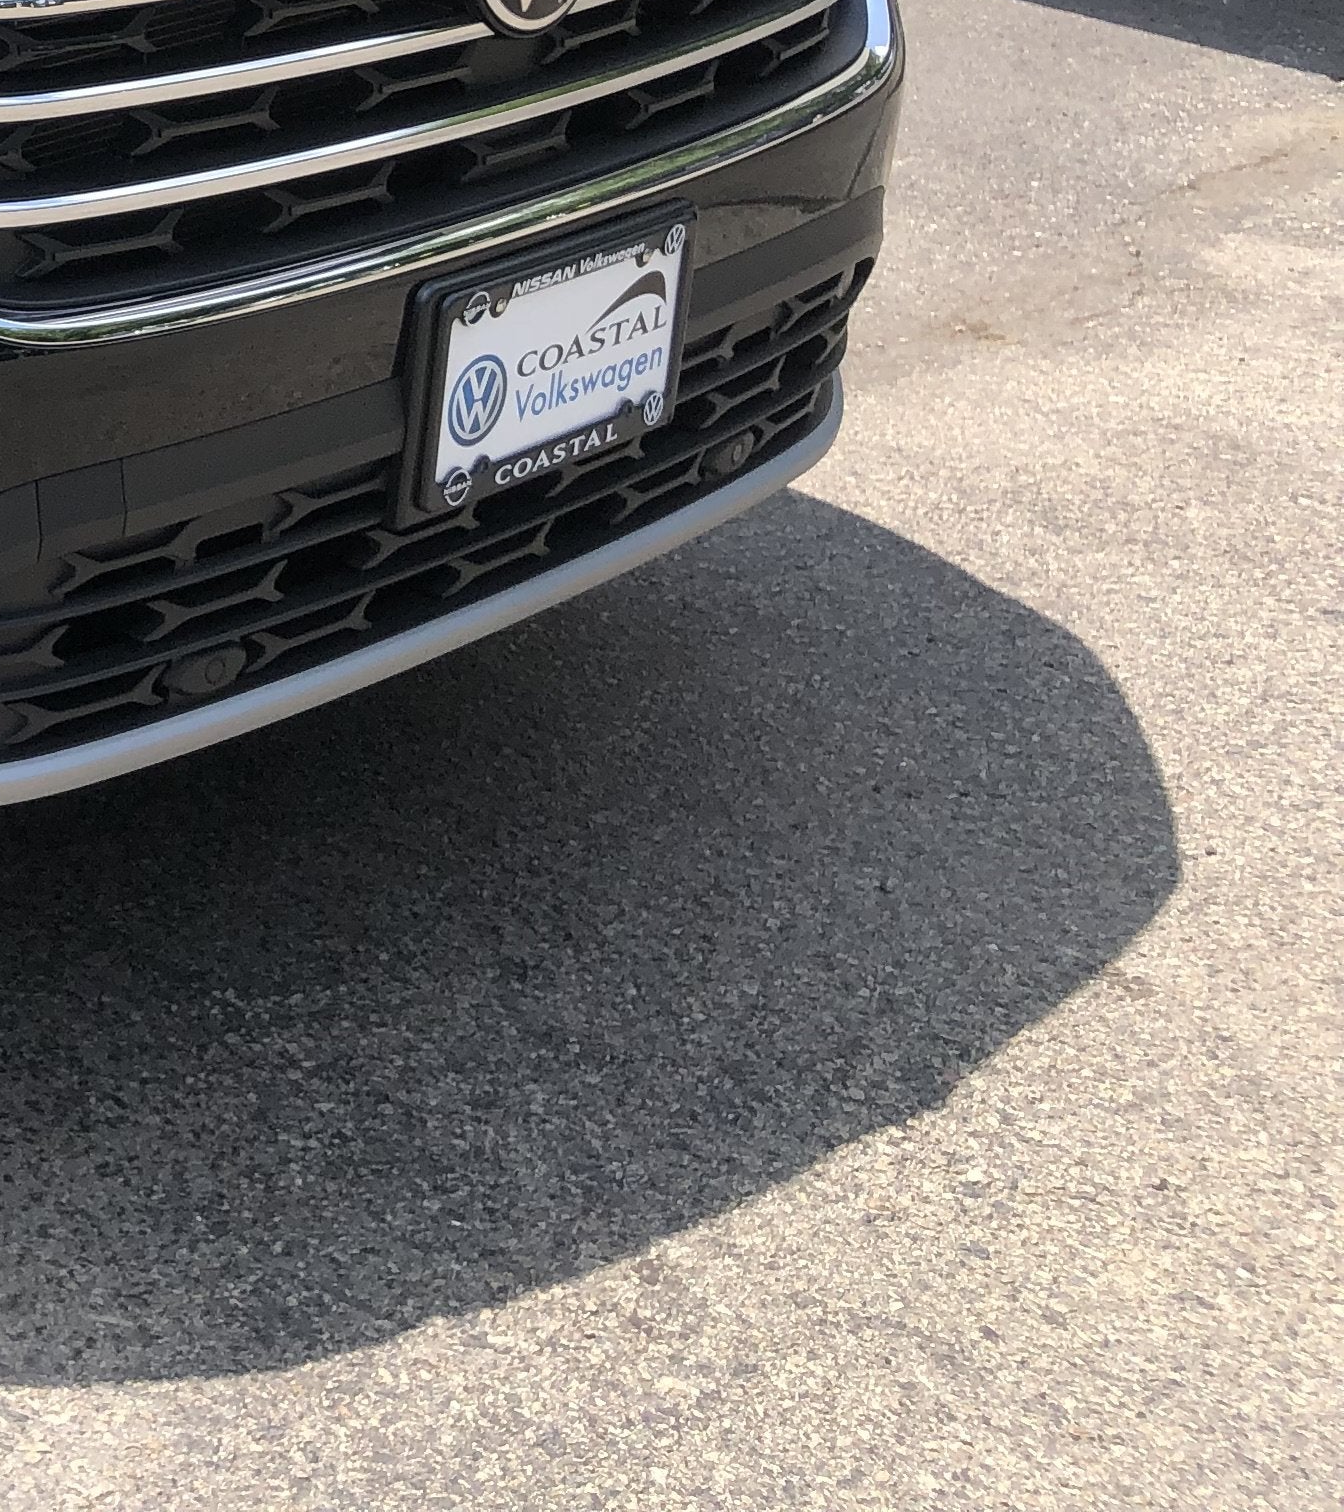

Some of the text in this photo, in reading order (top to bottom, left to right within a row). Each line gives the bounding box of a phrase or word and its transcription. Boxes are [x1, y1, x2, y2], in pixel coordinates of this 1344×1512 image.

[512, 242, 646, 298] NISSAN Volkswagen
[516, 306, 668, 378] COASTAL
[515, 346, 663, 423] Volkswagen
[494, 423, 618, 486] COASTAL
